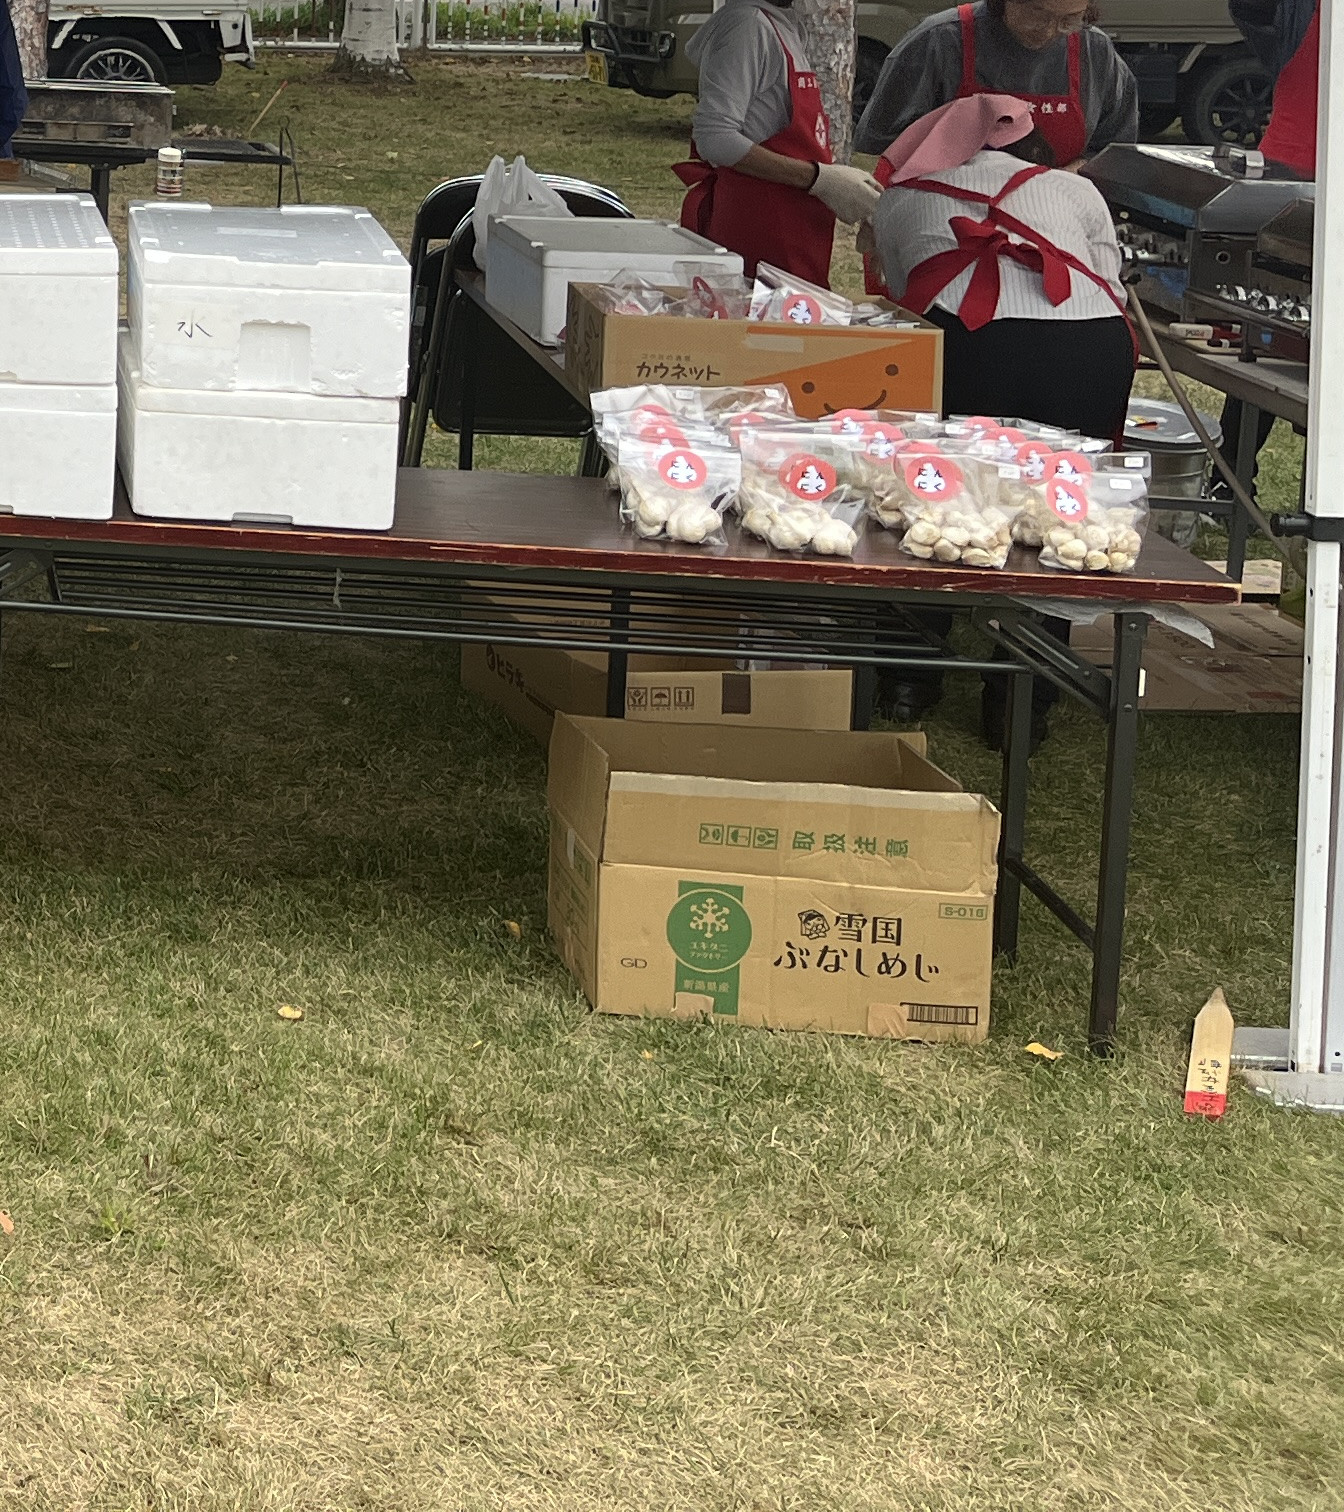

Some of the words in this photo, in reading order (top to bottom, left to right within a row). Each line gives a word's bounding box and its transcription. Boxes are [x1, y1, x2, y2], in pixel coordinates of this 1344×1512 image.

[636, 362, 721, 381] カウネット
[792, 830, 909, 858] 取扱注意
[834, 912, 903, 946] 雪国
[620, 957, 647, 969] GD
[773, 941, 940, 983] ぶなしめじ
